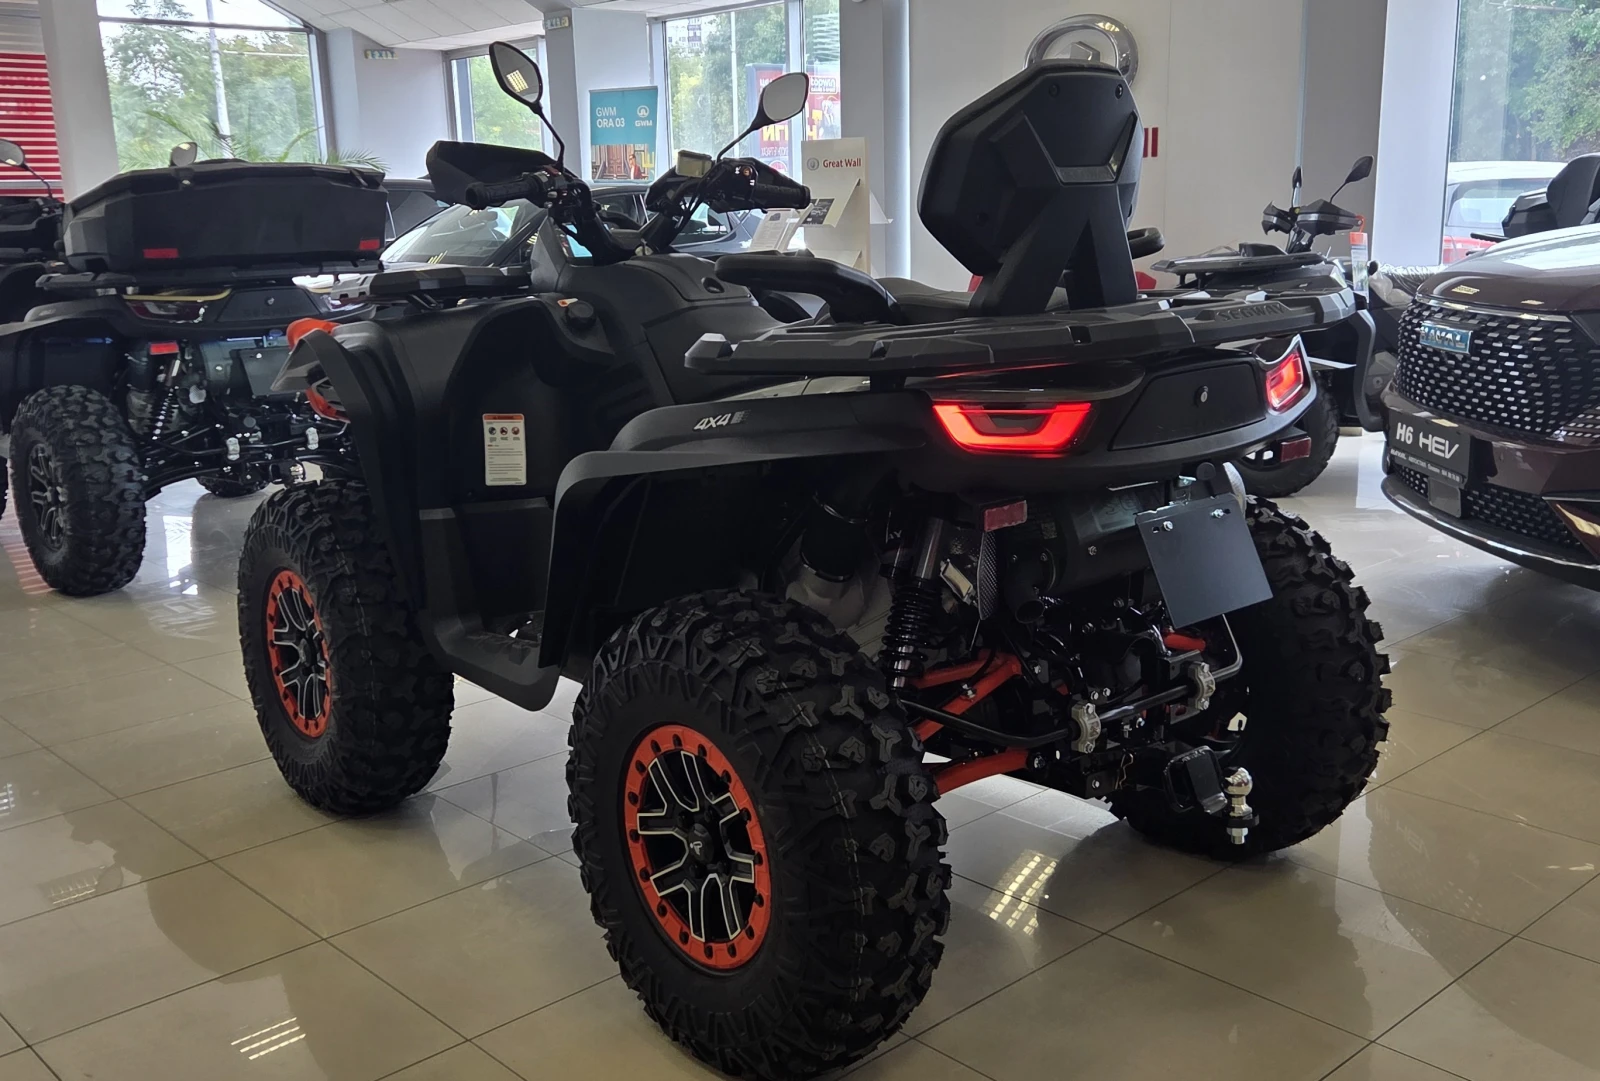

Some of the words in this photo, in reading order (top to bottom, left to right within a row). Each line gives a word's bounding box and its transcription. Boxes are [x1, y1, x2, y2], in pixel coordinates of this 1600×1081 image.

[595, 106, 617, 117] GWM
[596, 118, 614, 128] ORA
[615, 117, 625, 127] 03
[822, 159, 843, 168] Great
[844, 157, 861, 167] Wall
[1216, 302, 1285, 321] SEGWAY
[1396, 422, 1414, 444] H6
[1418, 431, 1460, 459] HEV
